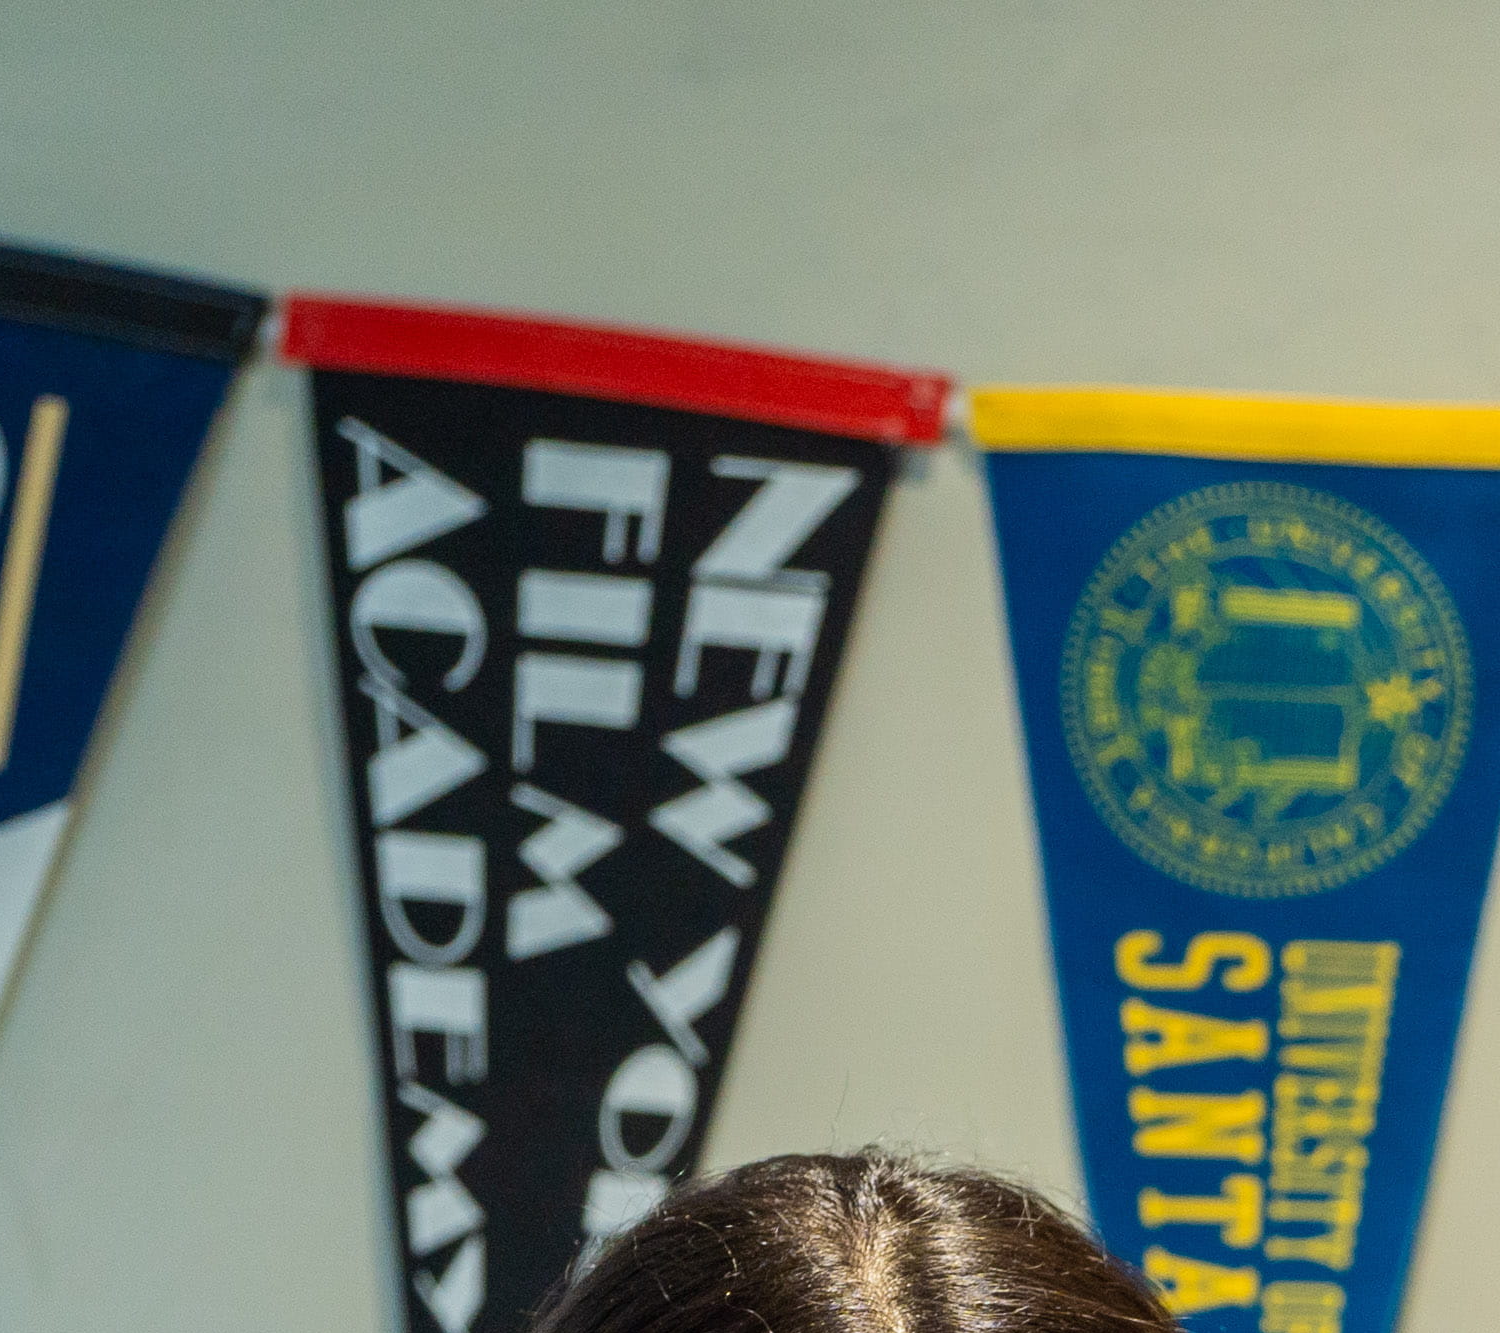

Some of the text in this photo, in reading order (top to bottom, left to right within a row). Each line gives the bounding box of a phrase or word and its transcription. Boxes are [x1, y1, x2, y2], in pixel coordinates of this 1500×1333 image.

[505, 436, 673, 962] FILM
[649, 455, 864, 890] NEW
[1114, 928, 1273, 1317] SANTA
[1263, 938, 1402, 1272] UNIVERSITY
